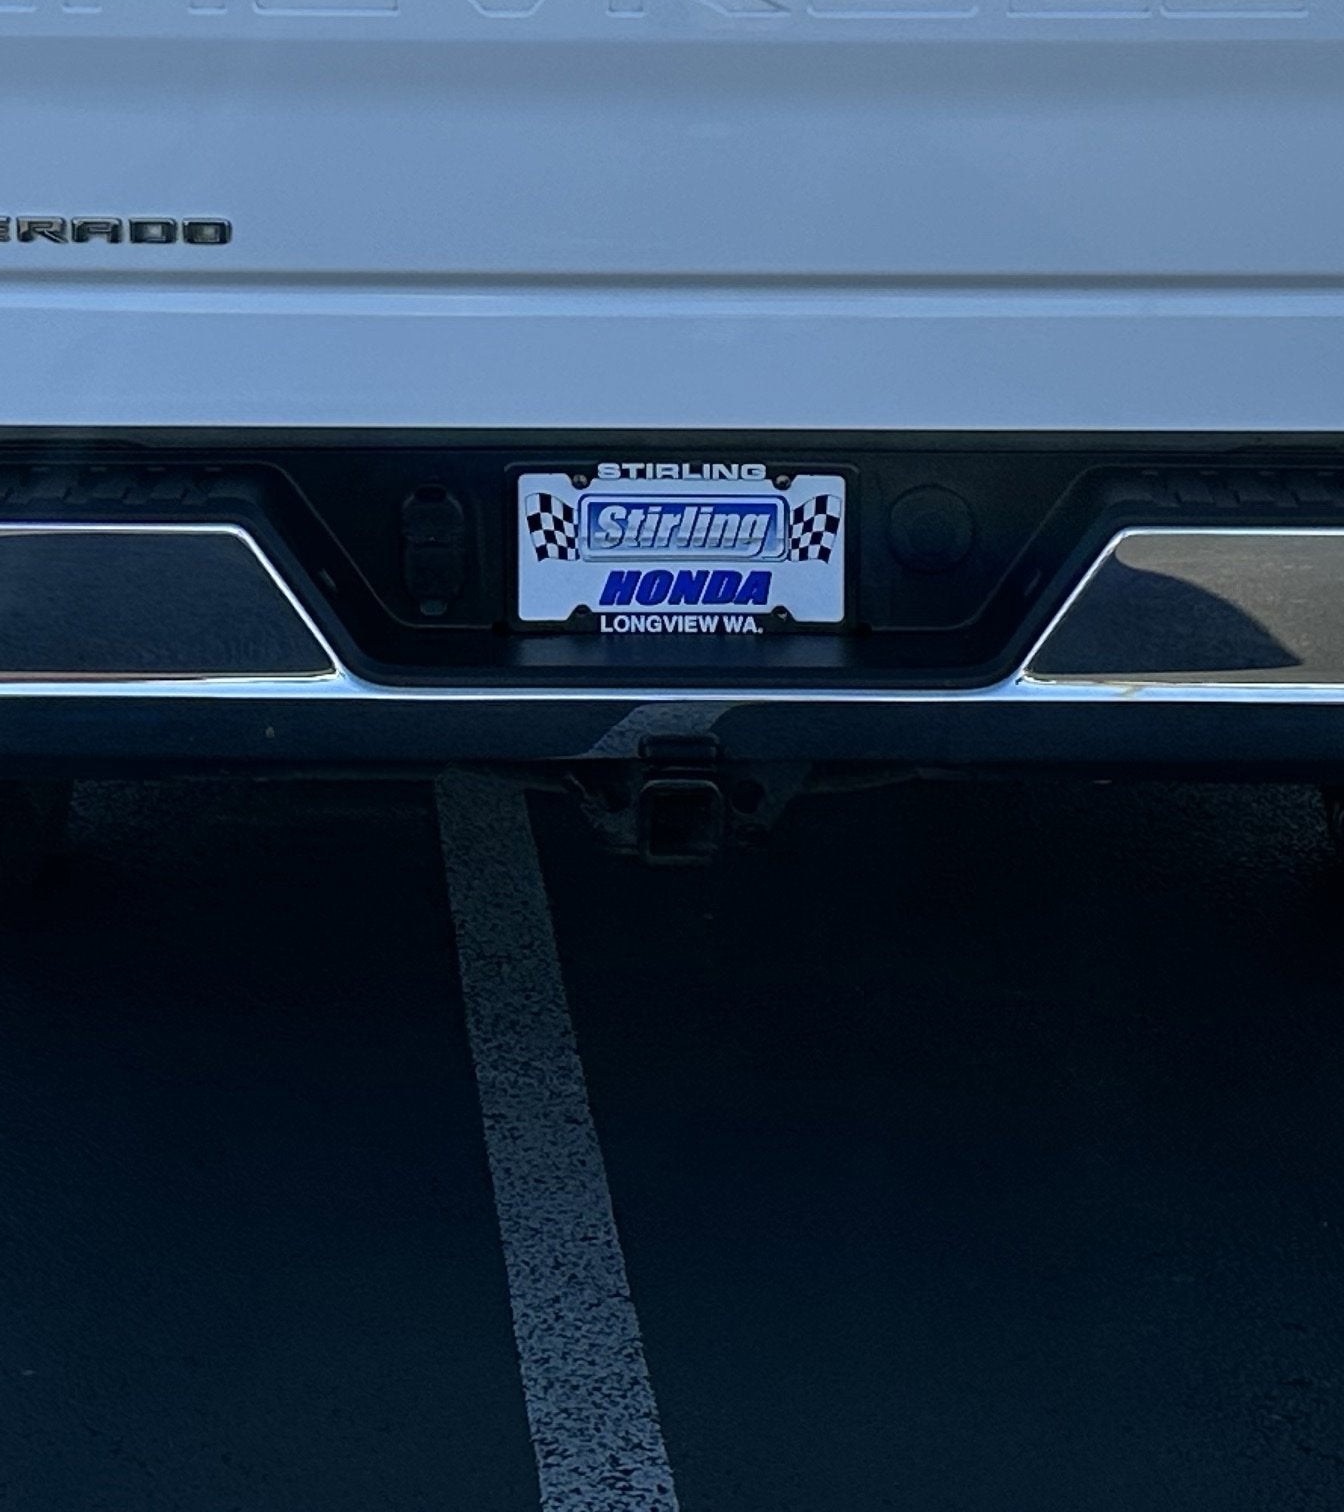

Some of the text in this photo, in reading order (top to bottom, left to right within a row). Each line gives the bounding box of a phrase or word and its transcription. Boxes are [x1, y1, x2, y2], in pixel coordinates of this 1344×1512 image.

[596, 462, 768, 481] STIRLING
[594, 504, 773, 558] Stirling
[598, 569, 773, 606] HONDA
[600, 614, 764, 634] LONGVIEW WA.
